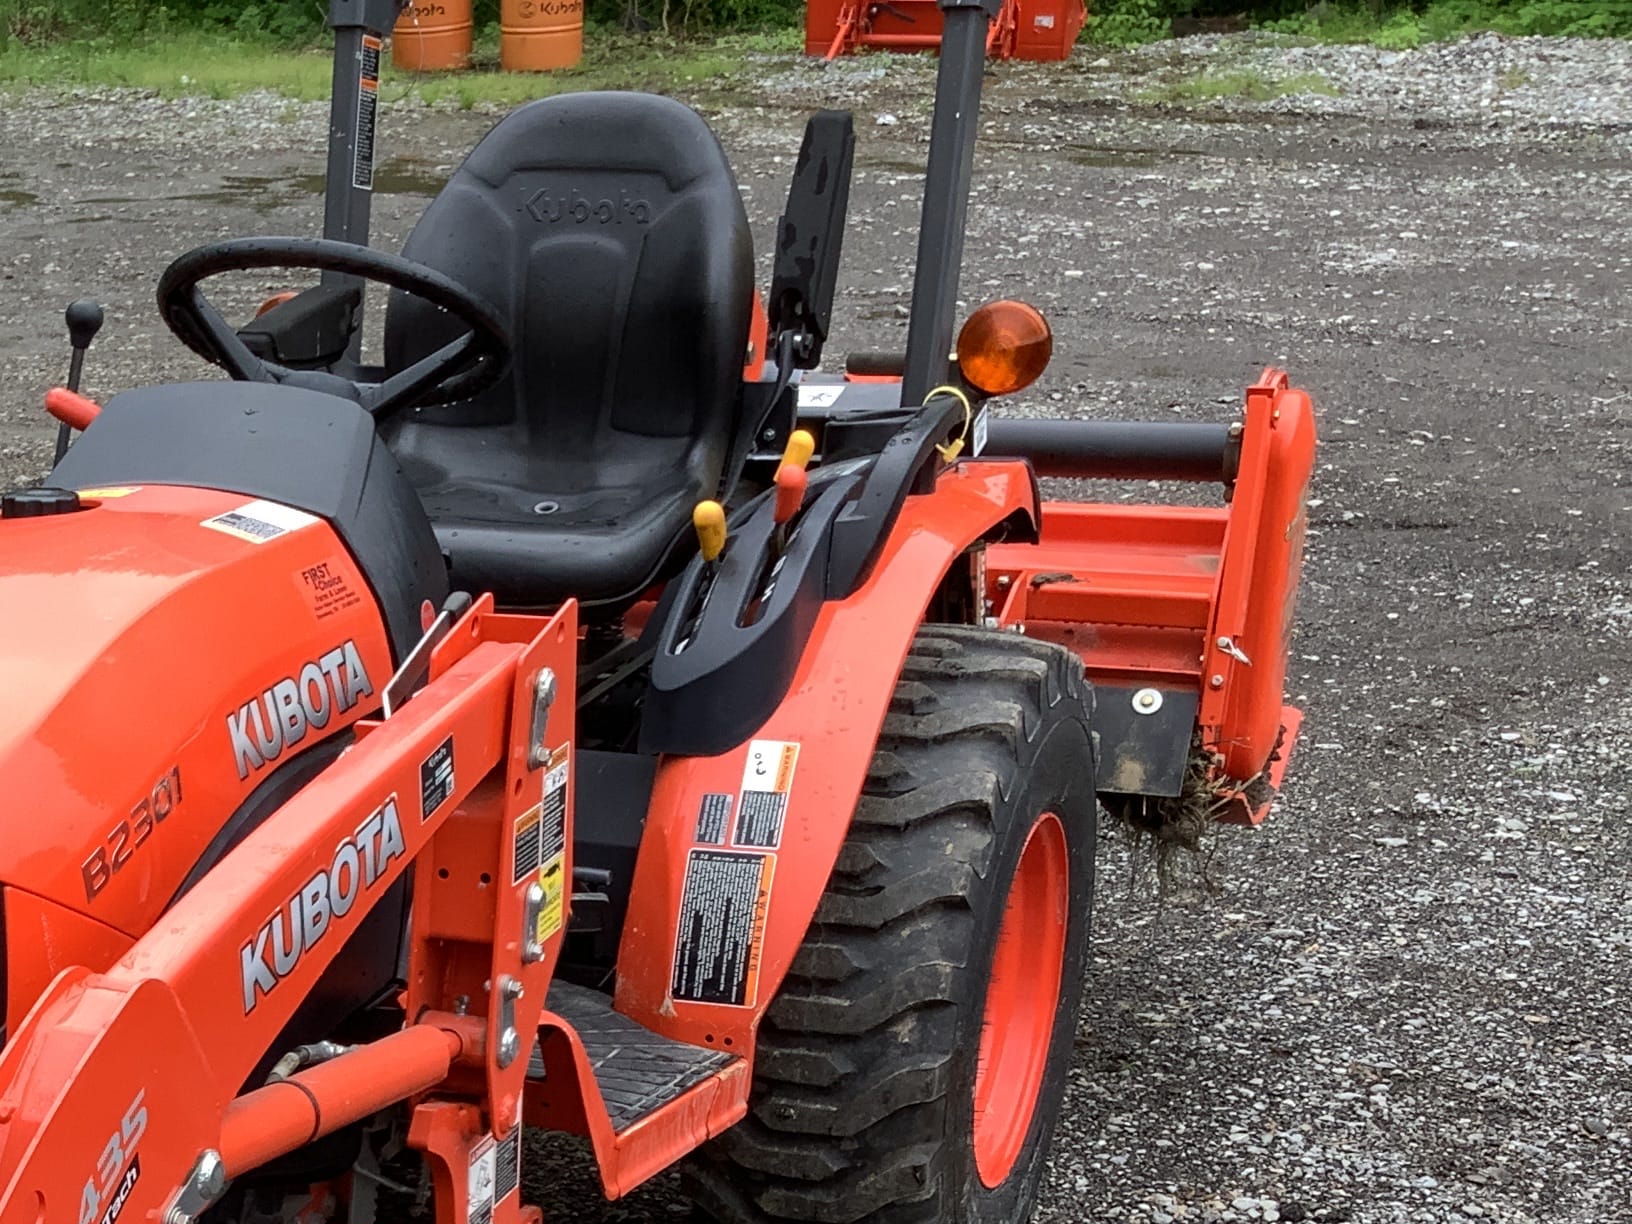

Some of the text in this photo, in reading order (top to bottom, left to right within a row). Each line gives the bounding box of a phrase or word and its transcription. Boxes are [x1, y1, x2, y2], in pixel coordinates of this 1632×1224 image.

[516, 186, 650, 224] Kubota
[301, 562, 331, 590] FIRST
[225, 638, 374, 781] KUBOTA
[80, 764, 183, 905] B2301
[240, 795, 406, 1016] KUBOTA
[750, 901, 766, 972] WARNING
